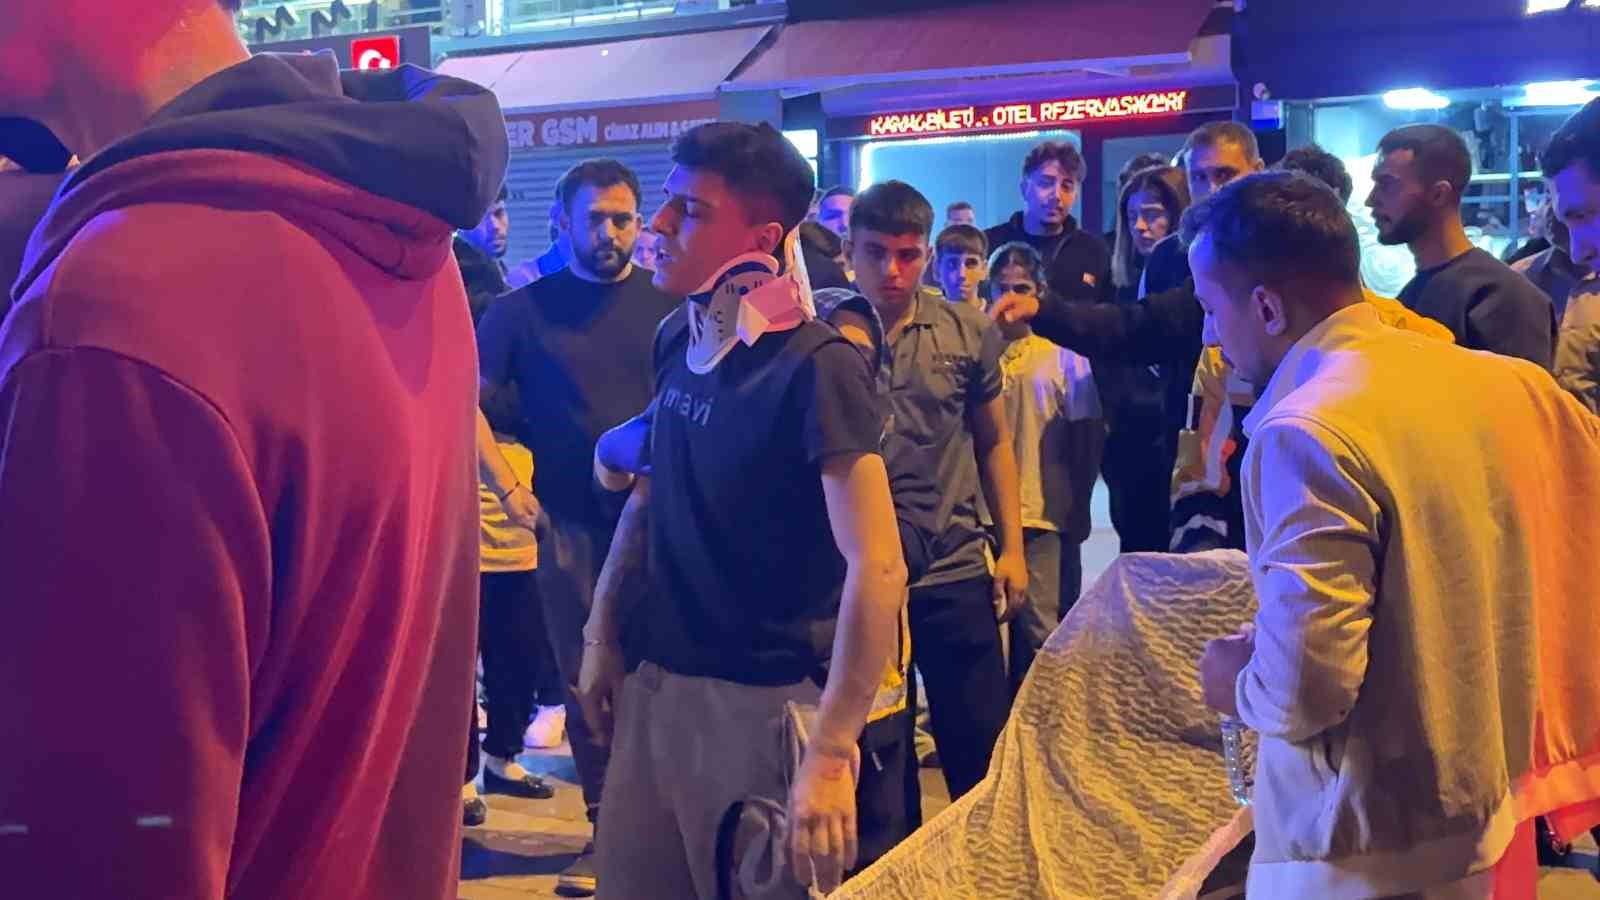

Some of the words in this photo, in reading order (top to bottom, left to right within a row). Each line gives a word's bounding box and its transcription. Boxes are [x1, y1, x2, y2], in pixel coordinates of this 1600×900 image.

[992, 103, 1037, 125] OTEL
[541, 116, 598, 146] GSM
[663, 390, 713, 426] mavi
